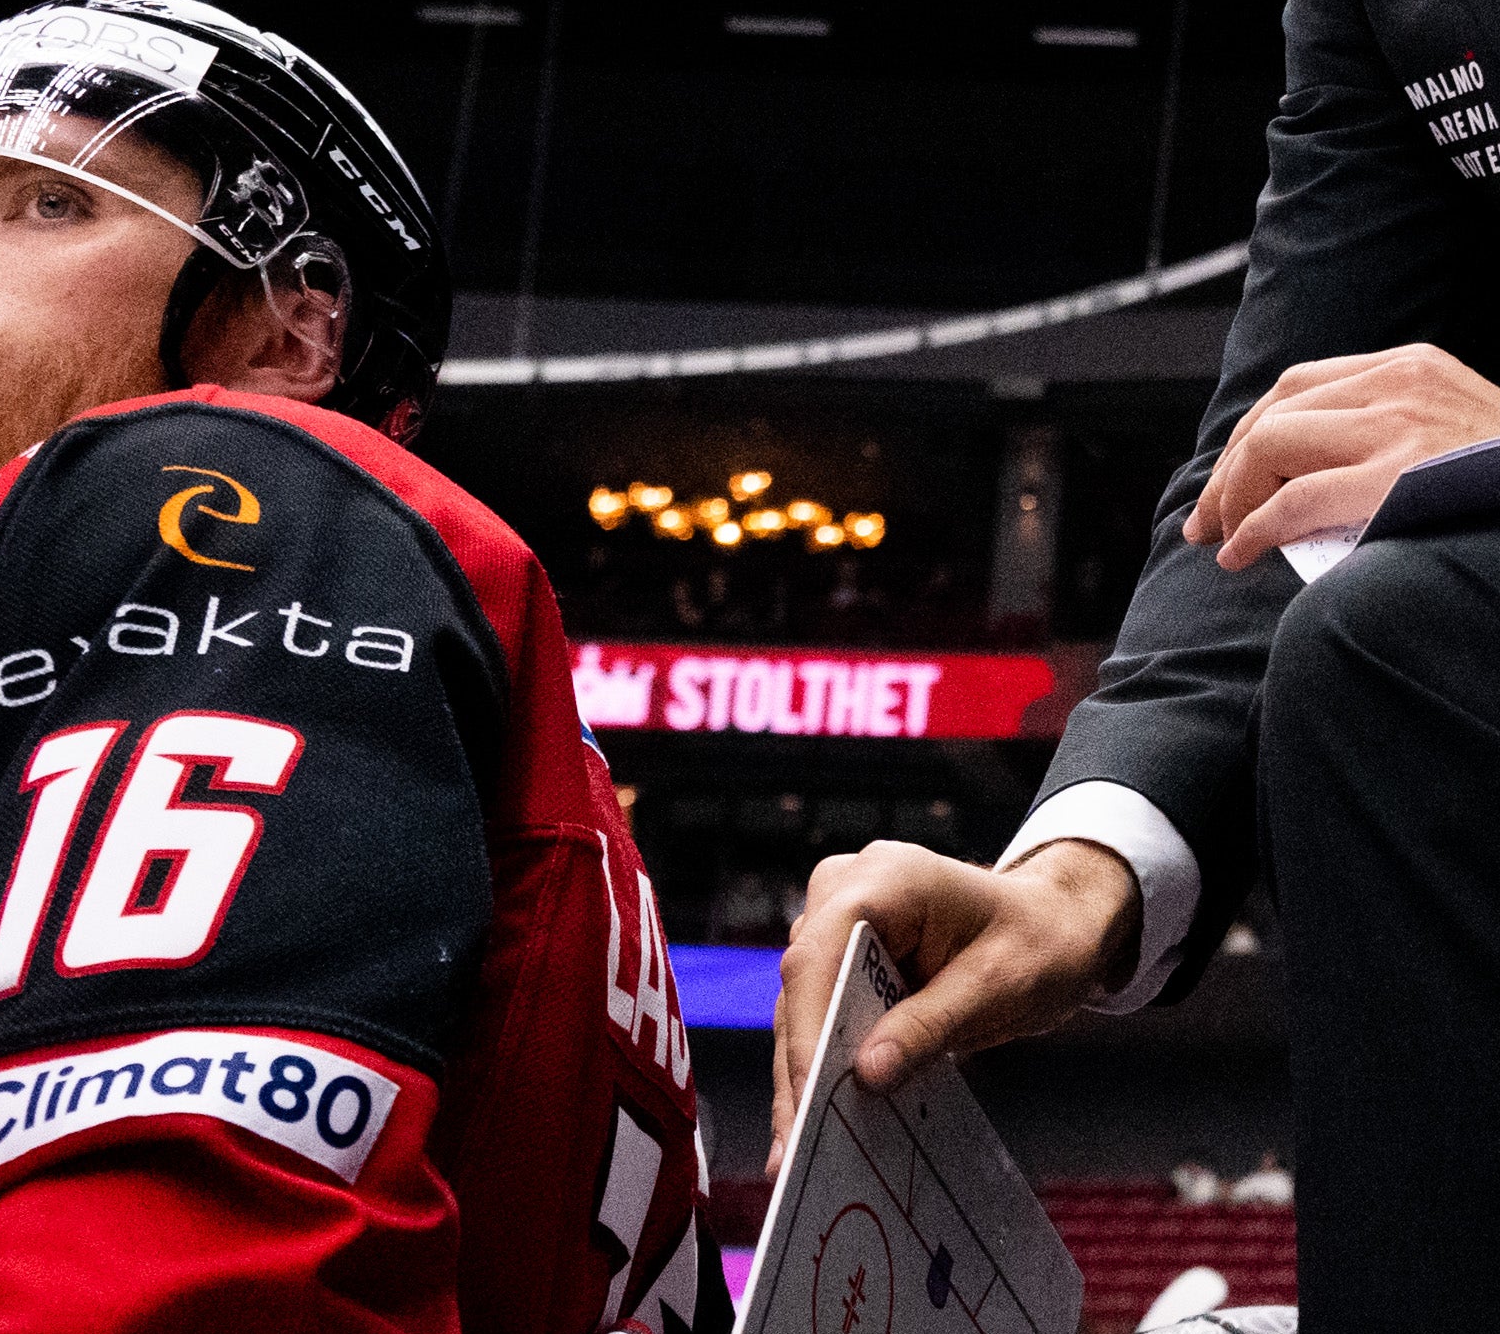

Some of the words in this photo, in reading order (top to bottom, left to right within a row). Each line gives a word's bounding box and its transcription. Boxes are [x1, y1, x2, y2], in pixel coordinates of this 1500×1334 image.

[1428, 102, 1499, 146] ARENA
[328, 145, 422, 251] CCM
[663, 655, 941, 738] STOLTHET
